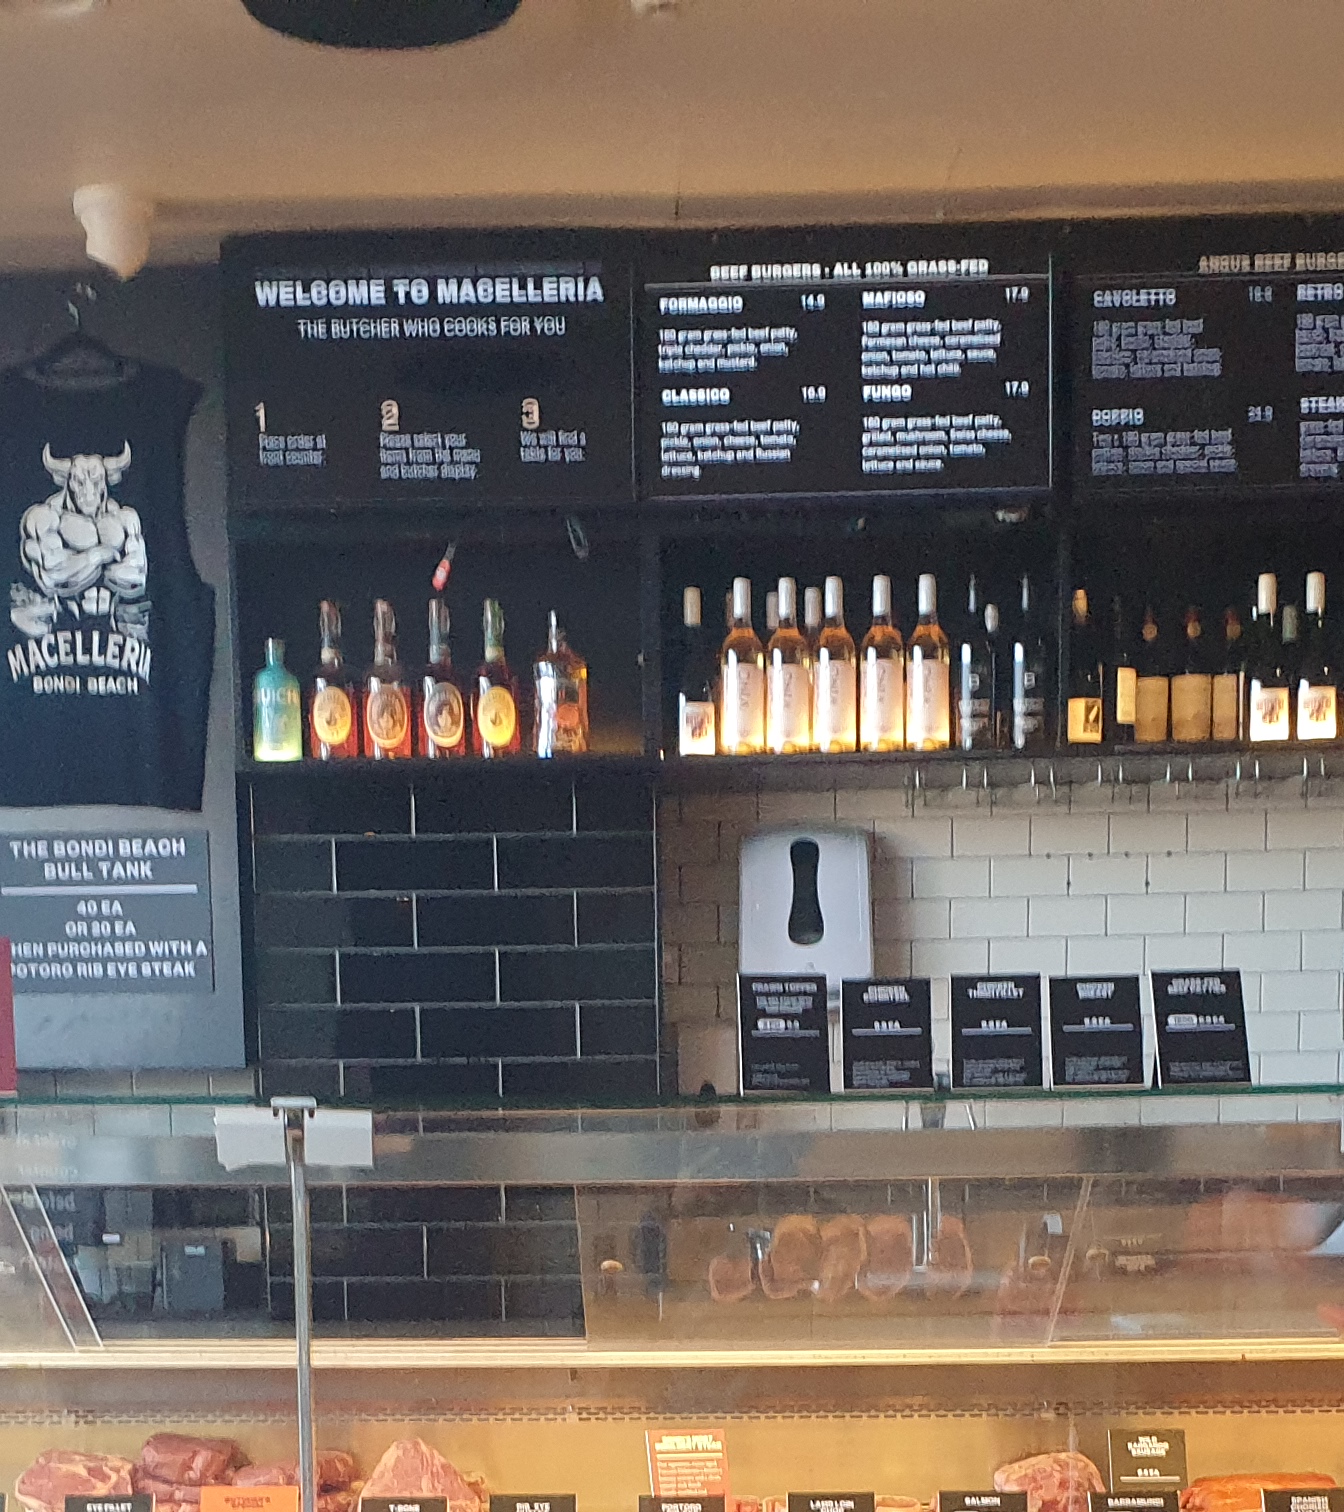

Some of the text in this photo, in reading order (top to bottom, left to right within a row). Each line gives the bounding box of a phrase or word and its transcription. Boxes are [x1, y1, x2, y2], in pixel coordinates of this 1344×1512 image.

[751, 264, 821, 281] BURGERS
[834, 262, 861, 279] ALL
[255, 276, 604, 307] WELCOME TO MACELLERIA
[298, 315, 566, 340] THE BUTCHER WHO COOKS FOR YOU
[254, 402, 266, 432] 1
[380, 399, 399, 431] 2
[521, 397, 539, 429] 3
[33, 674, 139, 696] BONDI BEACH
[9, 837, 186, 860] THE BONDI BEACH
[44, 860, 153, 881] BULL TANK
[101, 900, 123, 916] EA
[65, 920, 136, 937] OR EA
[11, 940, 208, 959] HEN PURCHASED WITH A
[77, 961, 103, 979] RIB
[107, 961, 137, 978] EYE
[141, 960, 196, 978] STEAK
